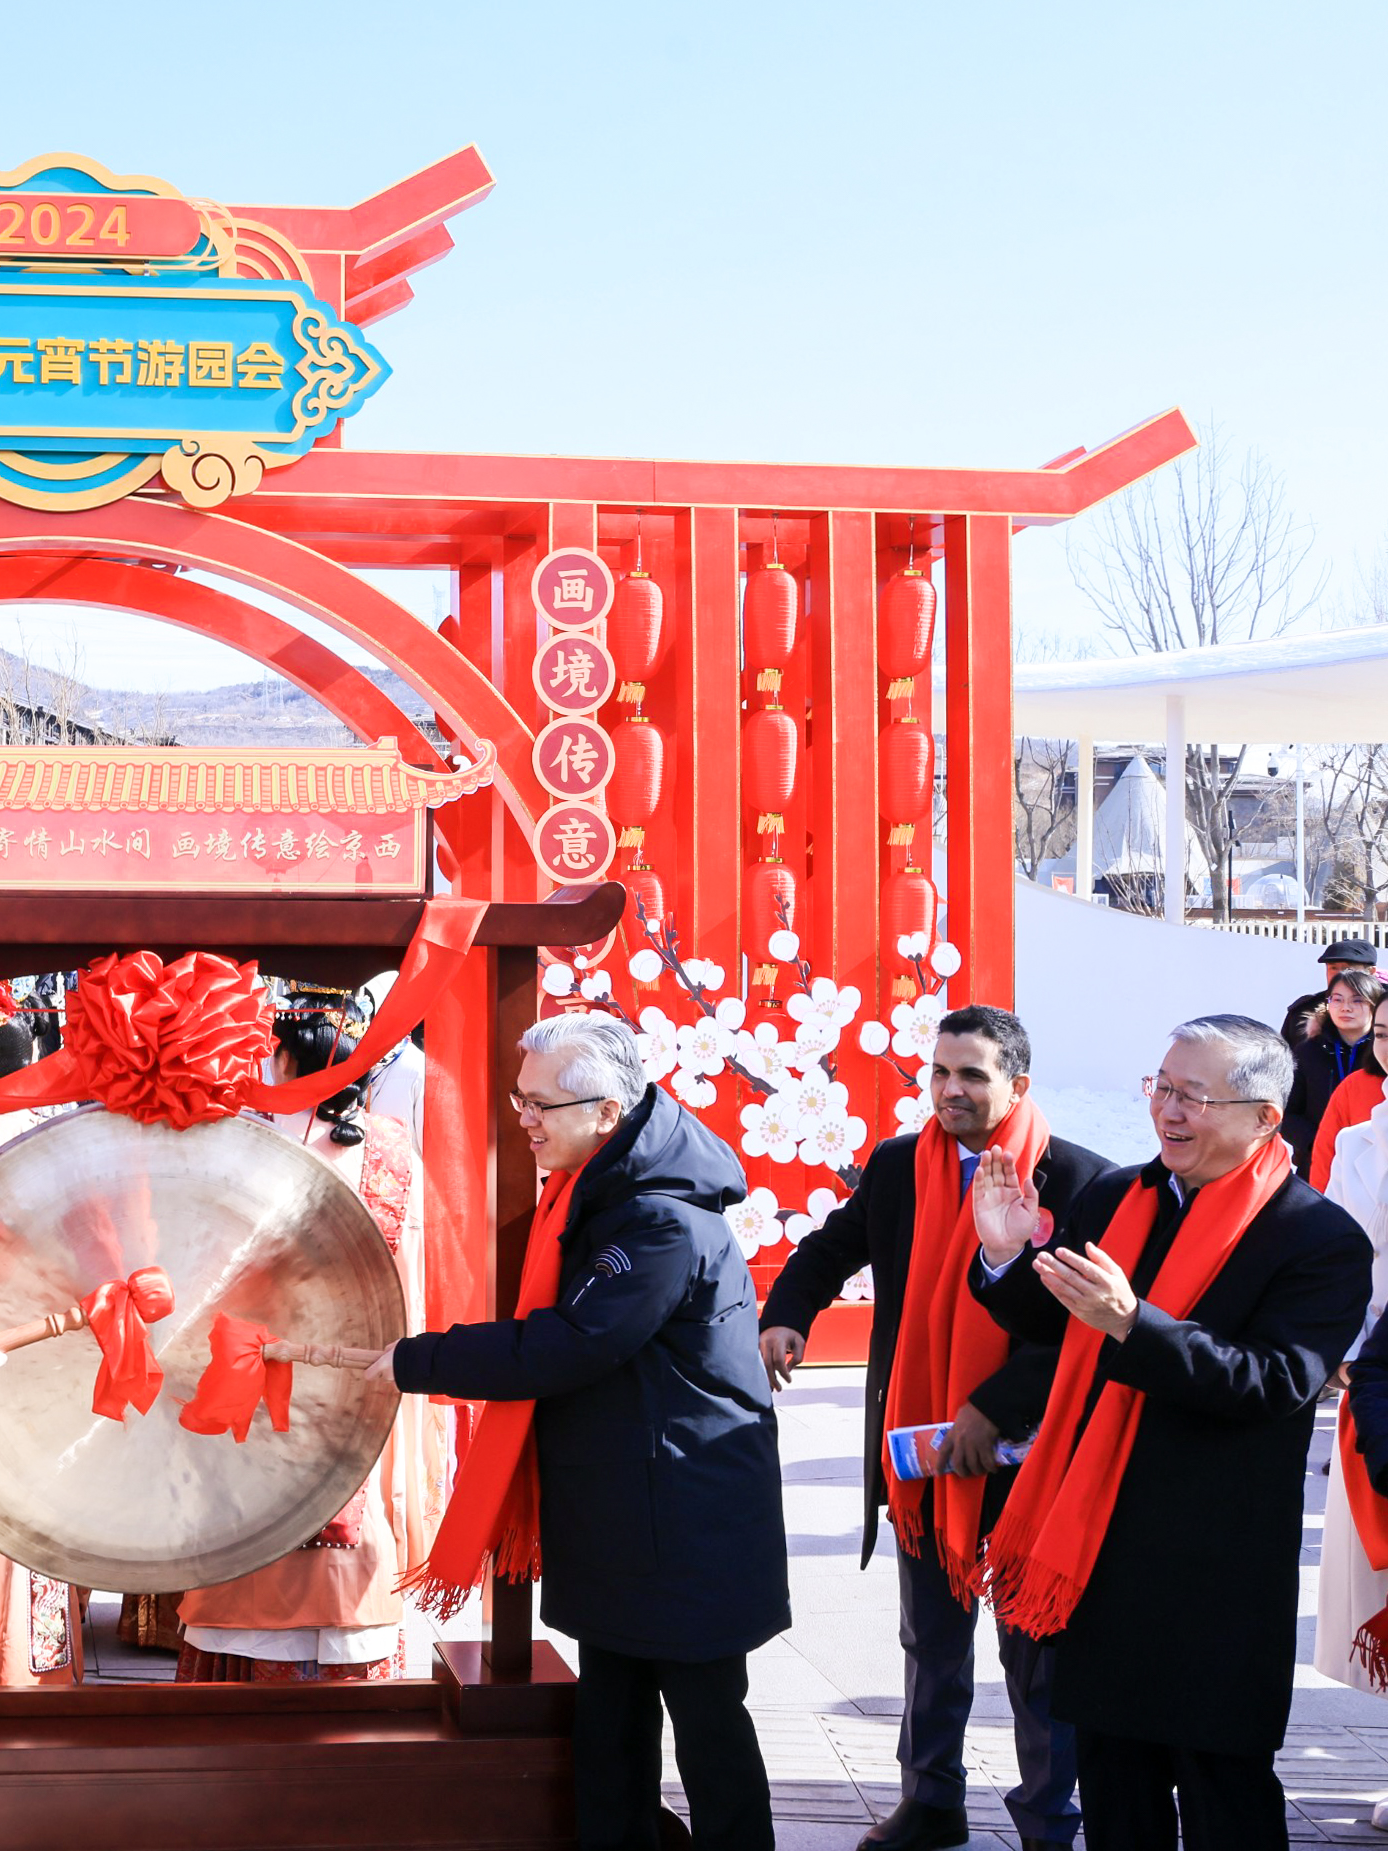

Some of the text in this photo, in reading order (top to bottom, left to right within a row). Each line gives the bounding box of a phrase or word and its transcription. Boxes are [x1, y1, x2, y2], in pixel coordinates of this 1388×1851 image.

[171, 829, 402, 863] 画境传意绘京西
